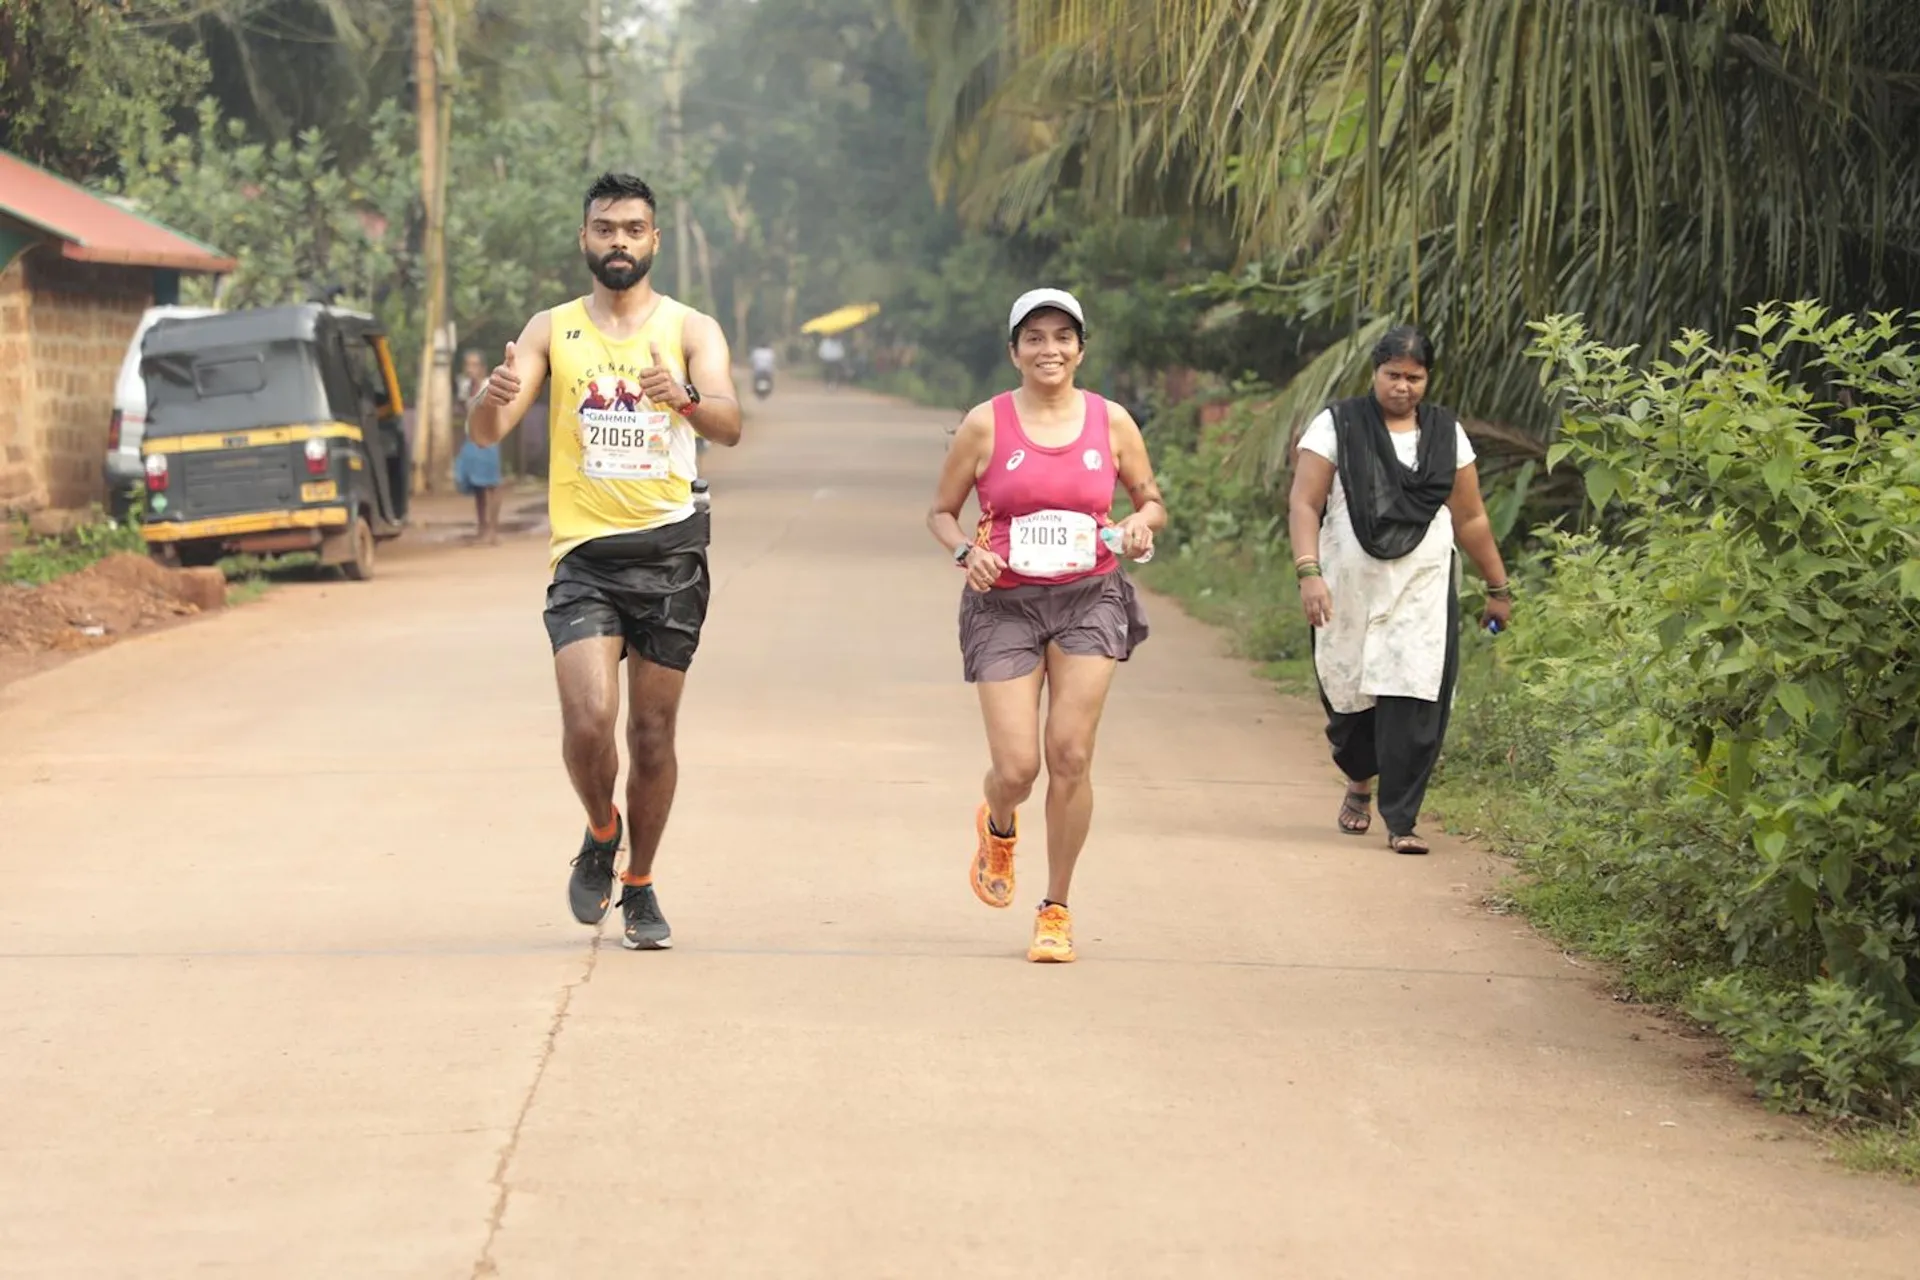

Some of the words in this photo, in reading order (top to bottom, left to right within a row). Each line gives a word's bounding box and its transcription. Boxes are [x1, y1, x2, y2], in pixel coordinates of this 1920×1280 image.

[589, 413, 637, 424] GARMIN
[590, 426, 644, 448] 21058
[1020, 526, 1067, 546] 21013
